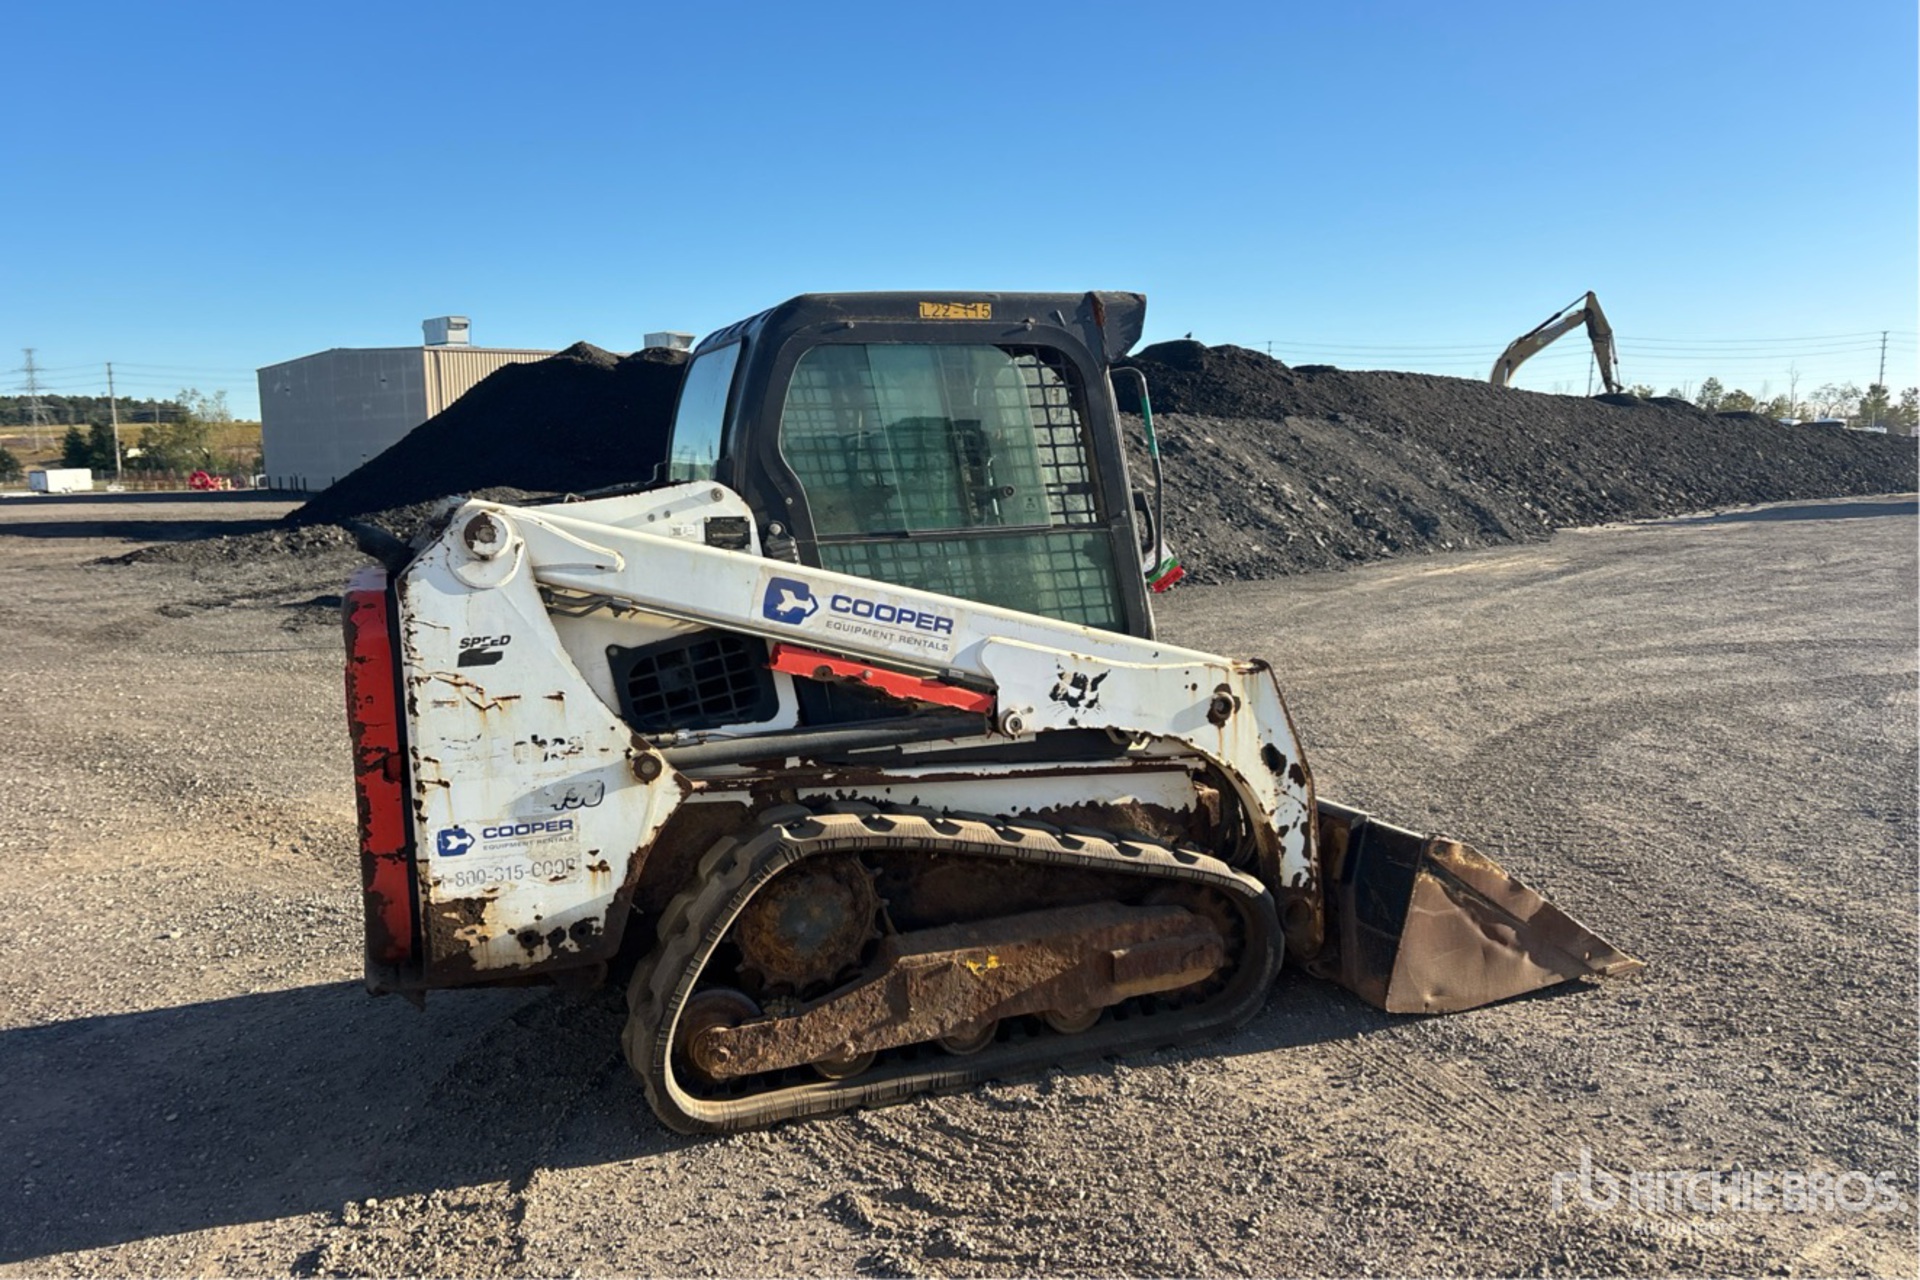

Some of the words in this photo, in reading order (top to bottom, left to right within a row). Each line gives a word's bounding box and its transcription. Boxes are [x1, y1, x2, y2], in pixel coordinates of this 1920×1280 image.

[830, 594, 954, 635] COOPER
[458, 633, 512, 649] SPEED
[825, 620, 896, 641] EQUIPMENT
[898, 635, 949, 652] RENTALS
[482, 819, 574, 839] COOPER
[482, 840, 535, 850] EQUIPMENT
[536, 835, 575, 845] RENTALS
